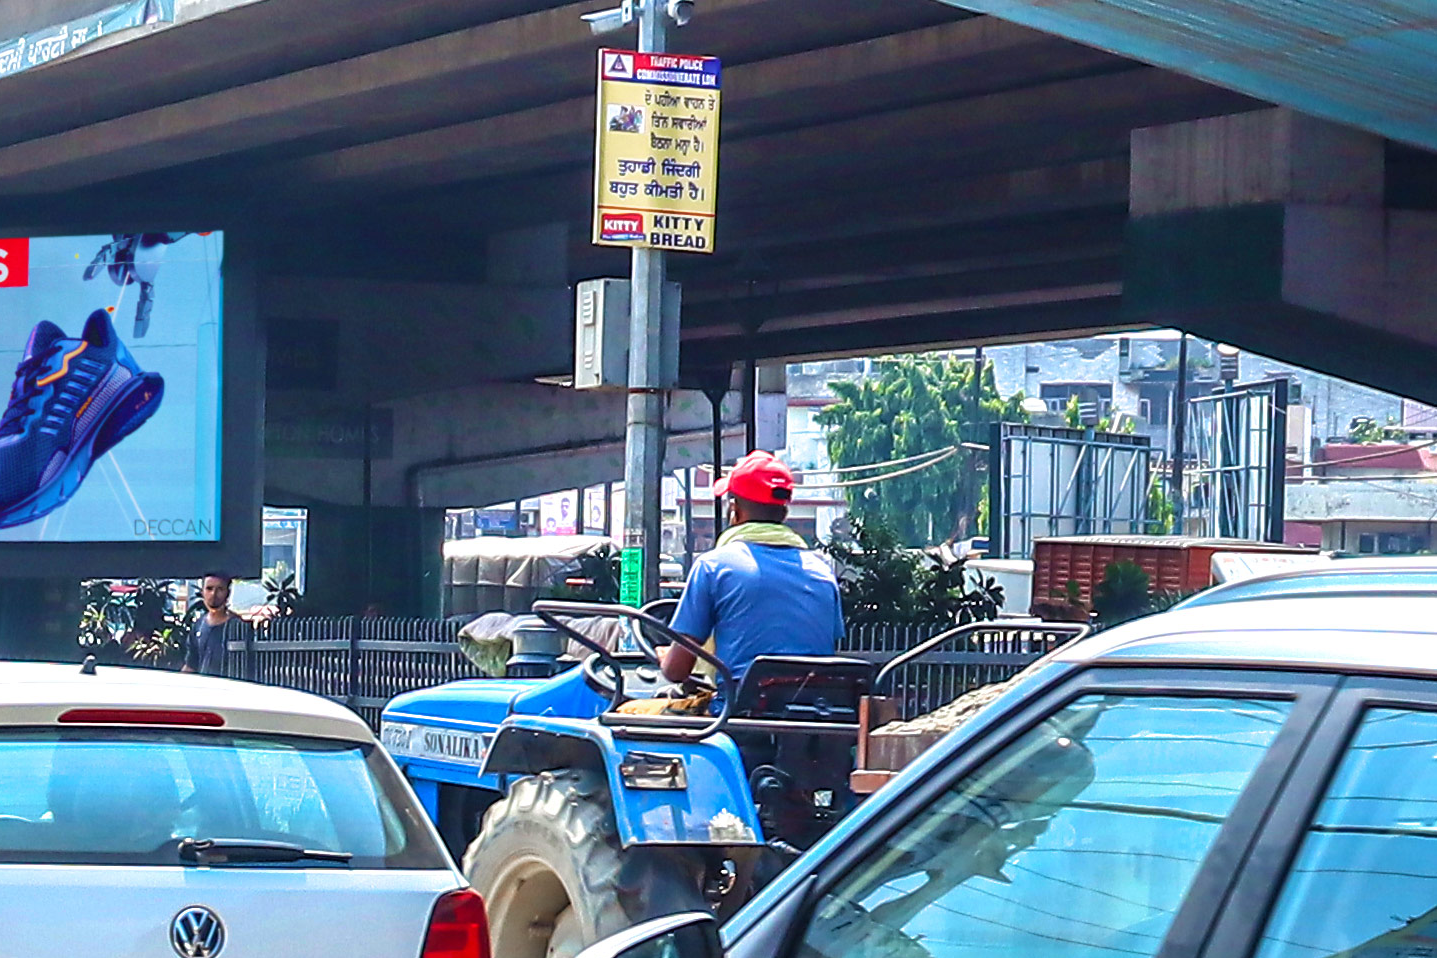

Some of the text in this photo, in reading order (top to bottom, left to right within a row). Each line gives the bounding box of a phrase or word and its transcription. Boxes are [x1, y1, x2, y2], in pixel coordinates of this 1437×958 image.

[650, 56, 704, 71] TRAFFIC POLICE
[604, 219, 639, 232] KITTY
[654, 215, 704, 231] KITTY
[650, 232, 706, 249] BREAD
[133, 517, 213, 536] DECCAN
[424, 731, 479, 759] SONALIKA
